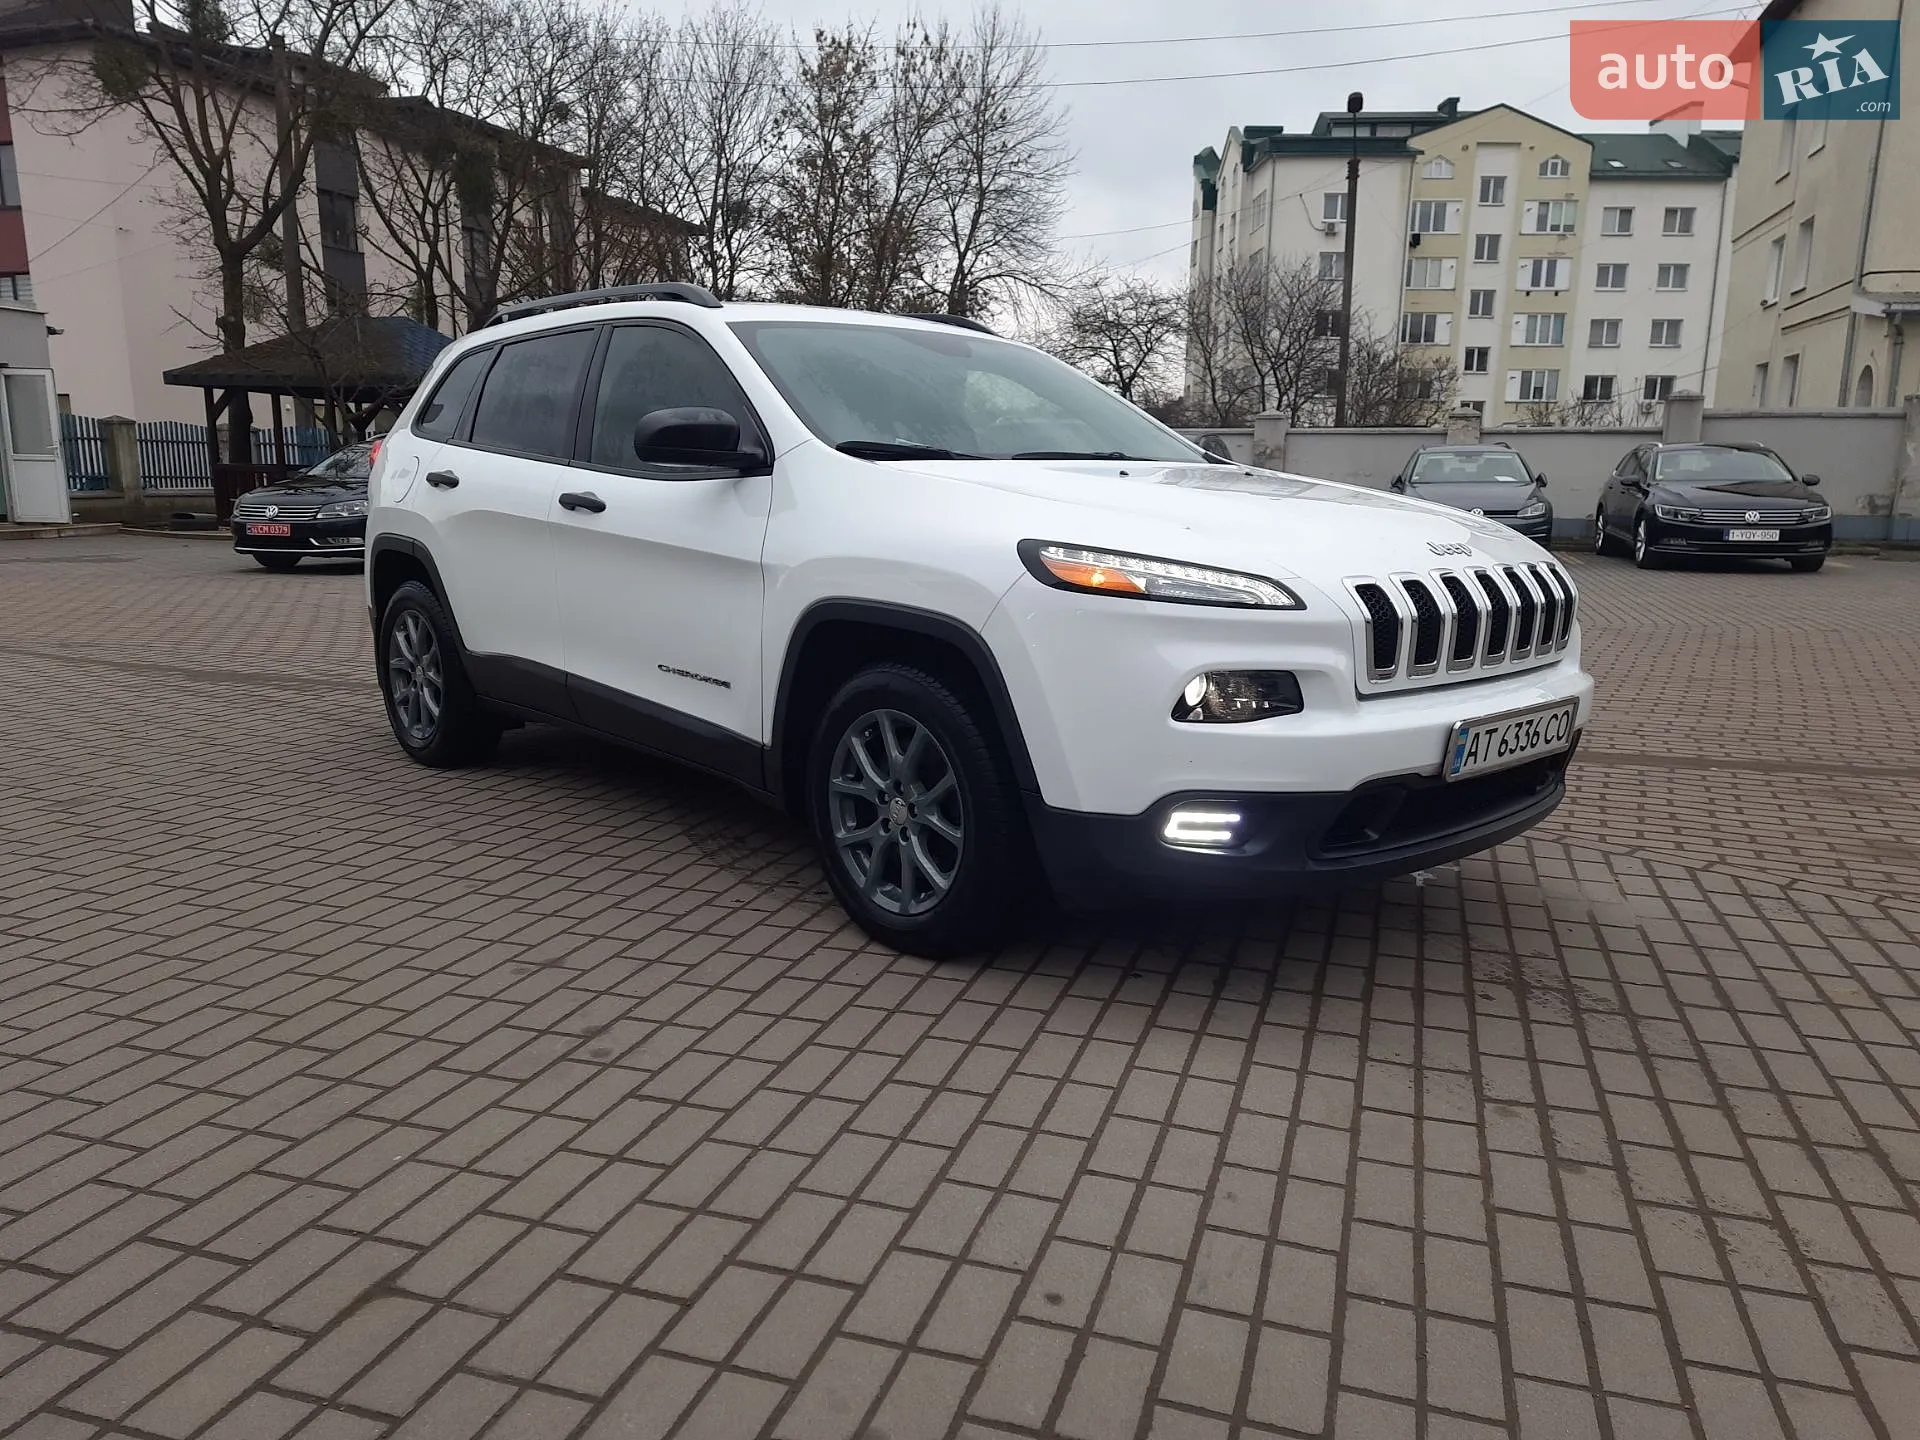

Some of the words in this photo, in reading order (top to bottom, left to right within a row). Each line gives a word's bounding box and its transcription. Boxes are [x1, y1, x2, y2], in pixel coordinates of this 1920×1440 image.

[1464, 728, 1498, 767] AT
[1497, 716, 1544, 758] 6336
[1544, 709, 1570, 745] CO
